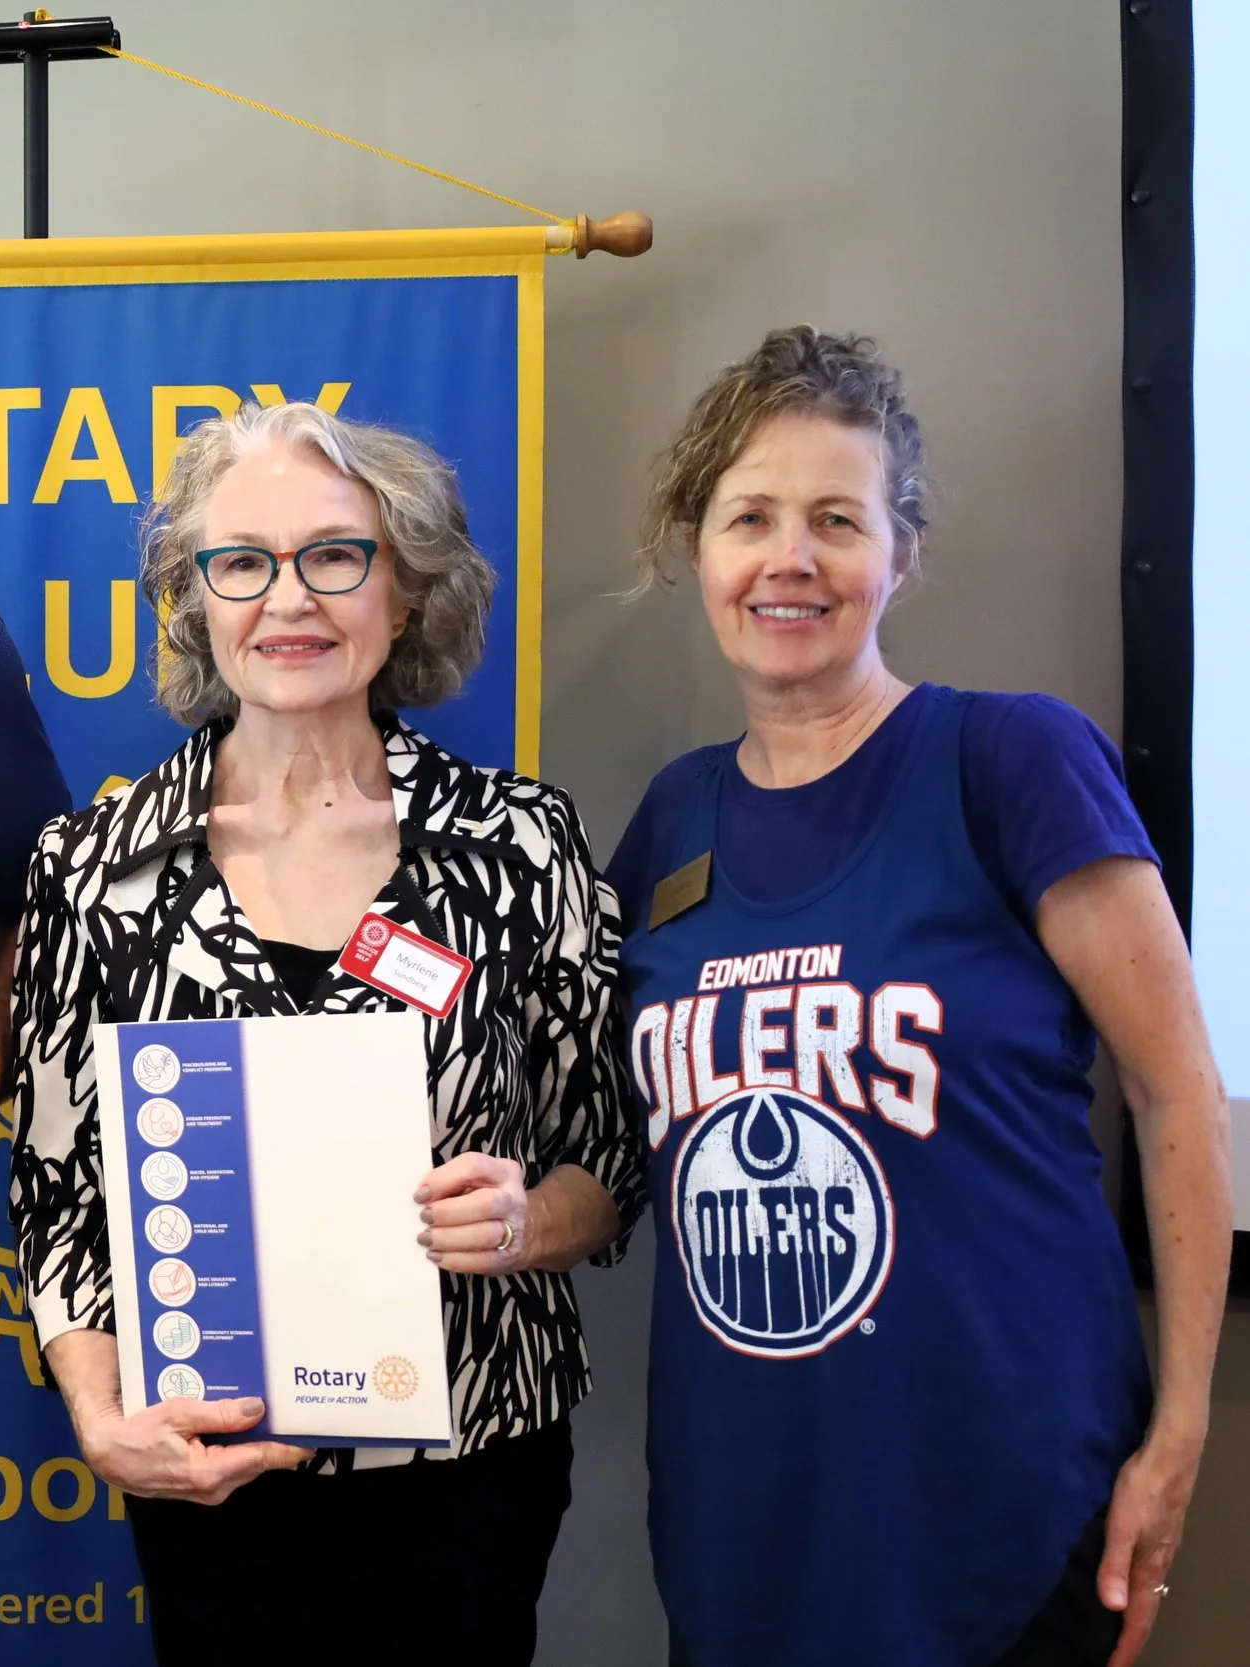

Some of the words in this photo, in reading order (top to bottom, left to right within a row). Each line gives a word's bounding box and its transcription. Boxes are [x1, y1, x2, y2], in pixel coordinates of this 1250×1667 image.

[355, 953, 369, 962] SELF
[356, 941, 378, 955] SERVICE
[396, 953, 439, 981] Myrlene
[697, 943, 843, 993] EDMONTON
[393, 969, 429, 992] Sundberg
[631, 981, 944, 1152] OILERS
[696, 1185, 857, 1288] OILERS
[294, 1366, 366, 1391] Rotary
[295, 1395, 326, 1404] PEOPLE
[336, 1396, 368, 1404] ACTION
